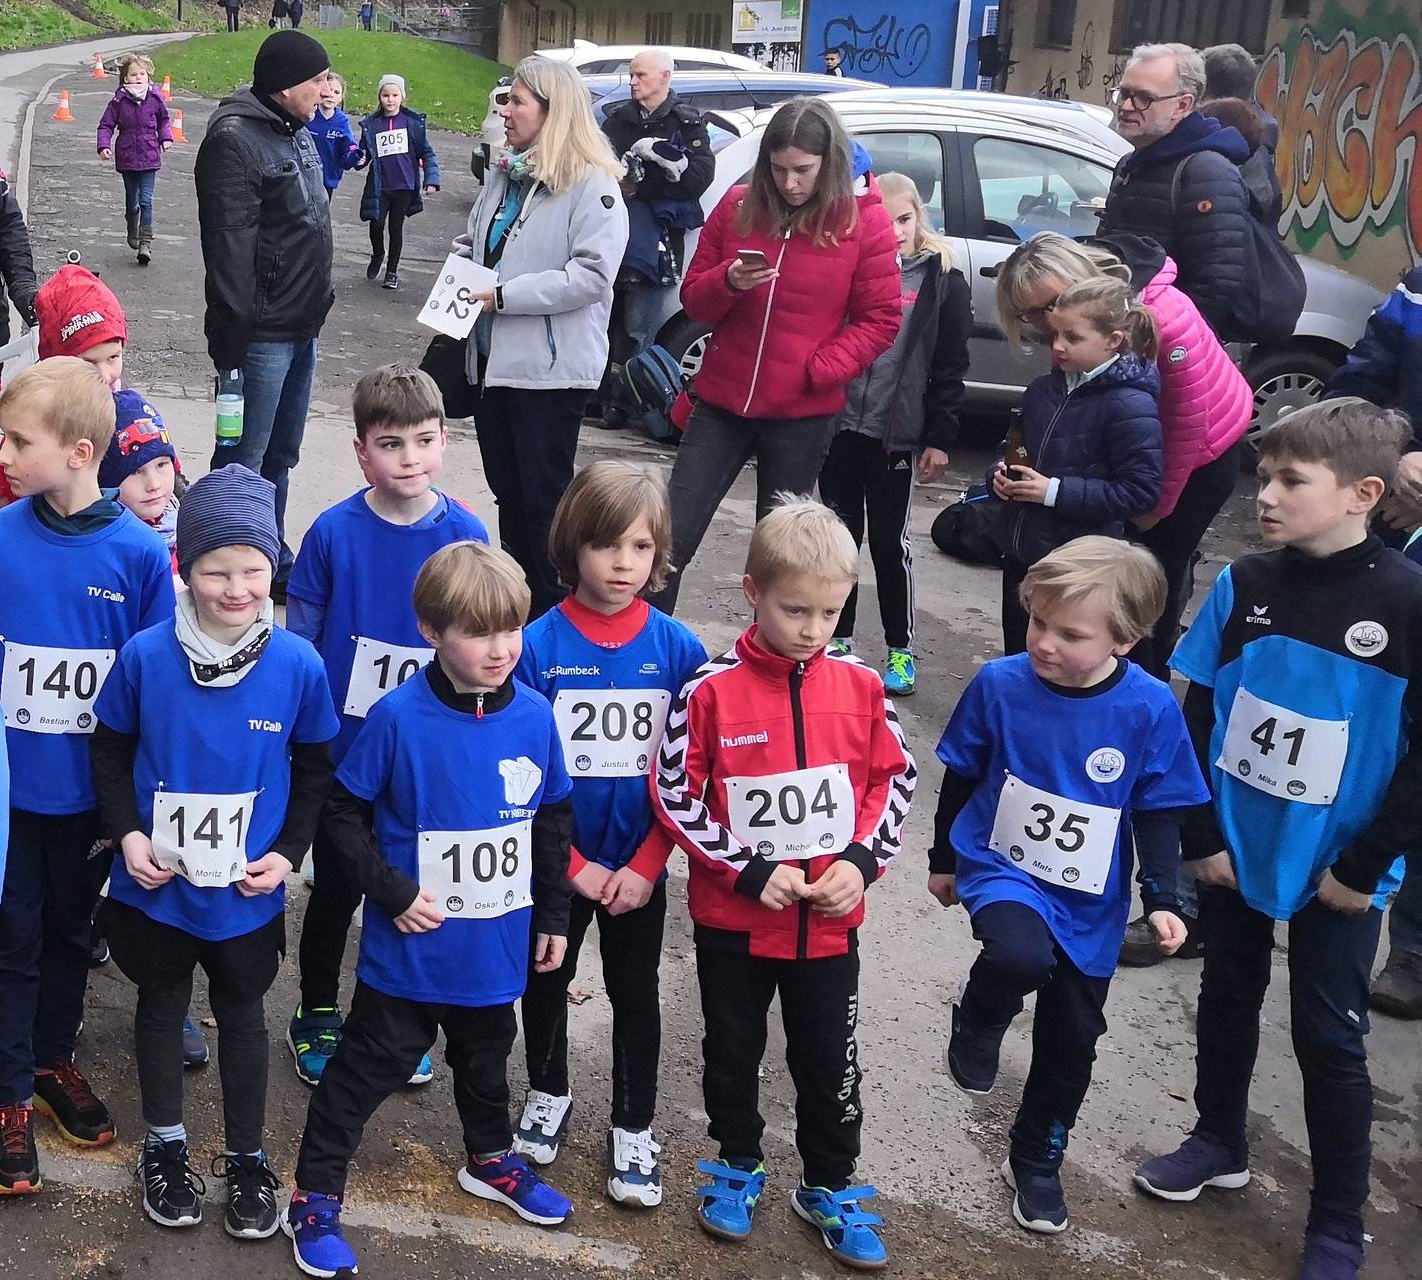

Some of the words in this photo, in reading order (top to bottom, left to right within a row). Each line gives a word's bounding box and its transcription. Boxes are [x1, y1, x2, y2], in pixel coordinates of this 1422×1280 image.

[380, 132, 403, 147] 205
[86, 585, 102, 597] TV
[1246, 615, 1272, 625] erima
[18, 657, 98, 701] 140
[373, 654, 420, 690] 10
[39, 716, 70, 726] Bastian
[248, 719, 263, 730] TV
[570, 701, 653, 741] 208
[720, 730, 769, 748] hummel
[1250, 716, 1306, 767] 41
[601, 760, 629, 768] Justus
[1257, 772, 1278, 787] Mika
[745, 778, 838, 828] 204
[169, 806, 244, 849] 141
[1024, 803, 1090, 853] 35
[441, 836, 519, 883] 108
[194, 869, 223, 878] Moritz
